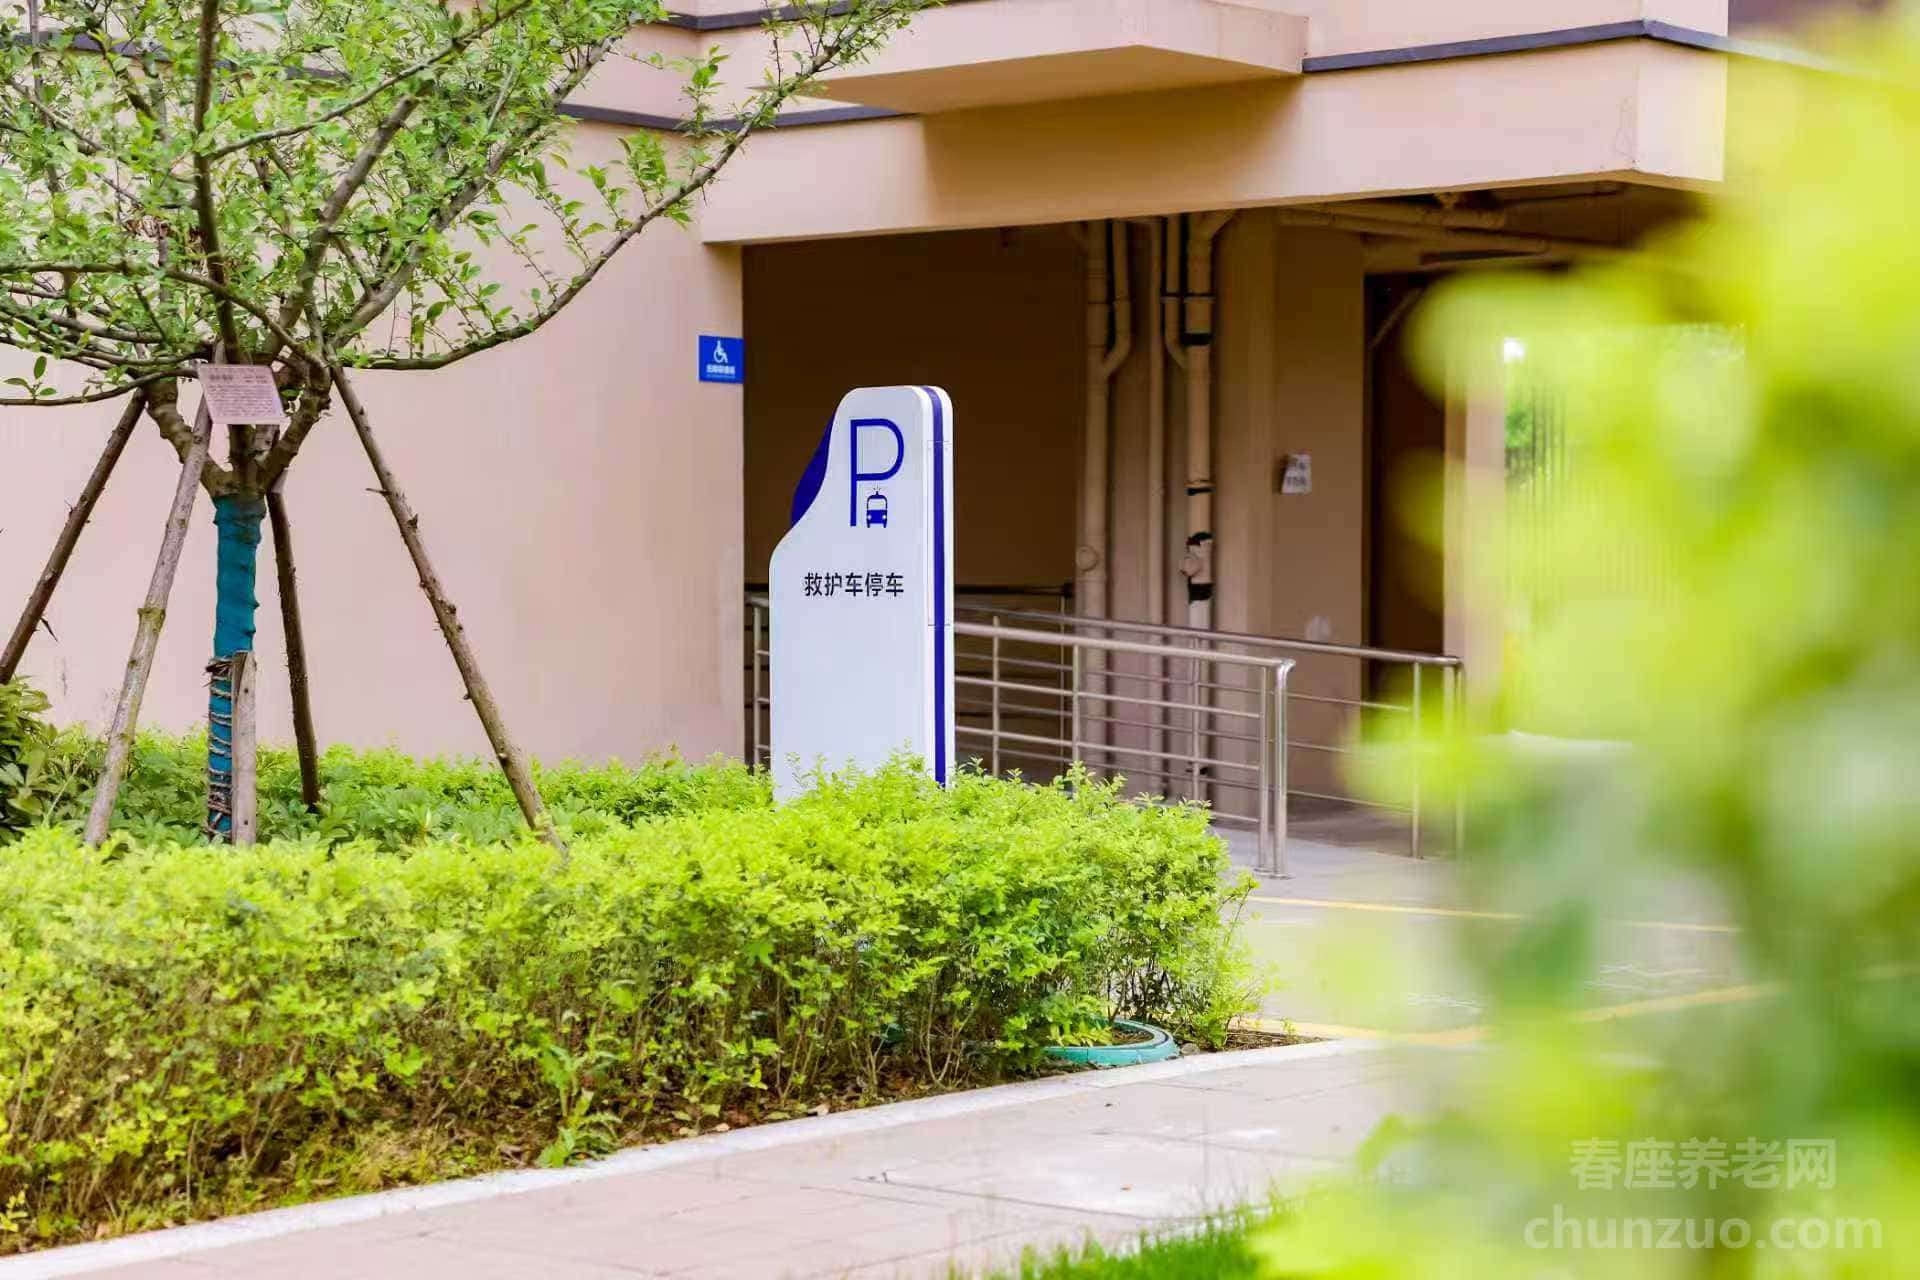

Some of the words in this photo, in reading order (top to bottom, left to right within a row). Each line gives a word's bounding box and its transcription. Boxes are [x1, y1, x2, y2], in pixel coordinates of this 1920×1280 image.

[850, 418, 904, 526] P
[804, 572, 904, 597] 救护车停车
